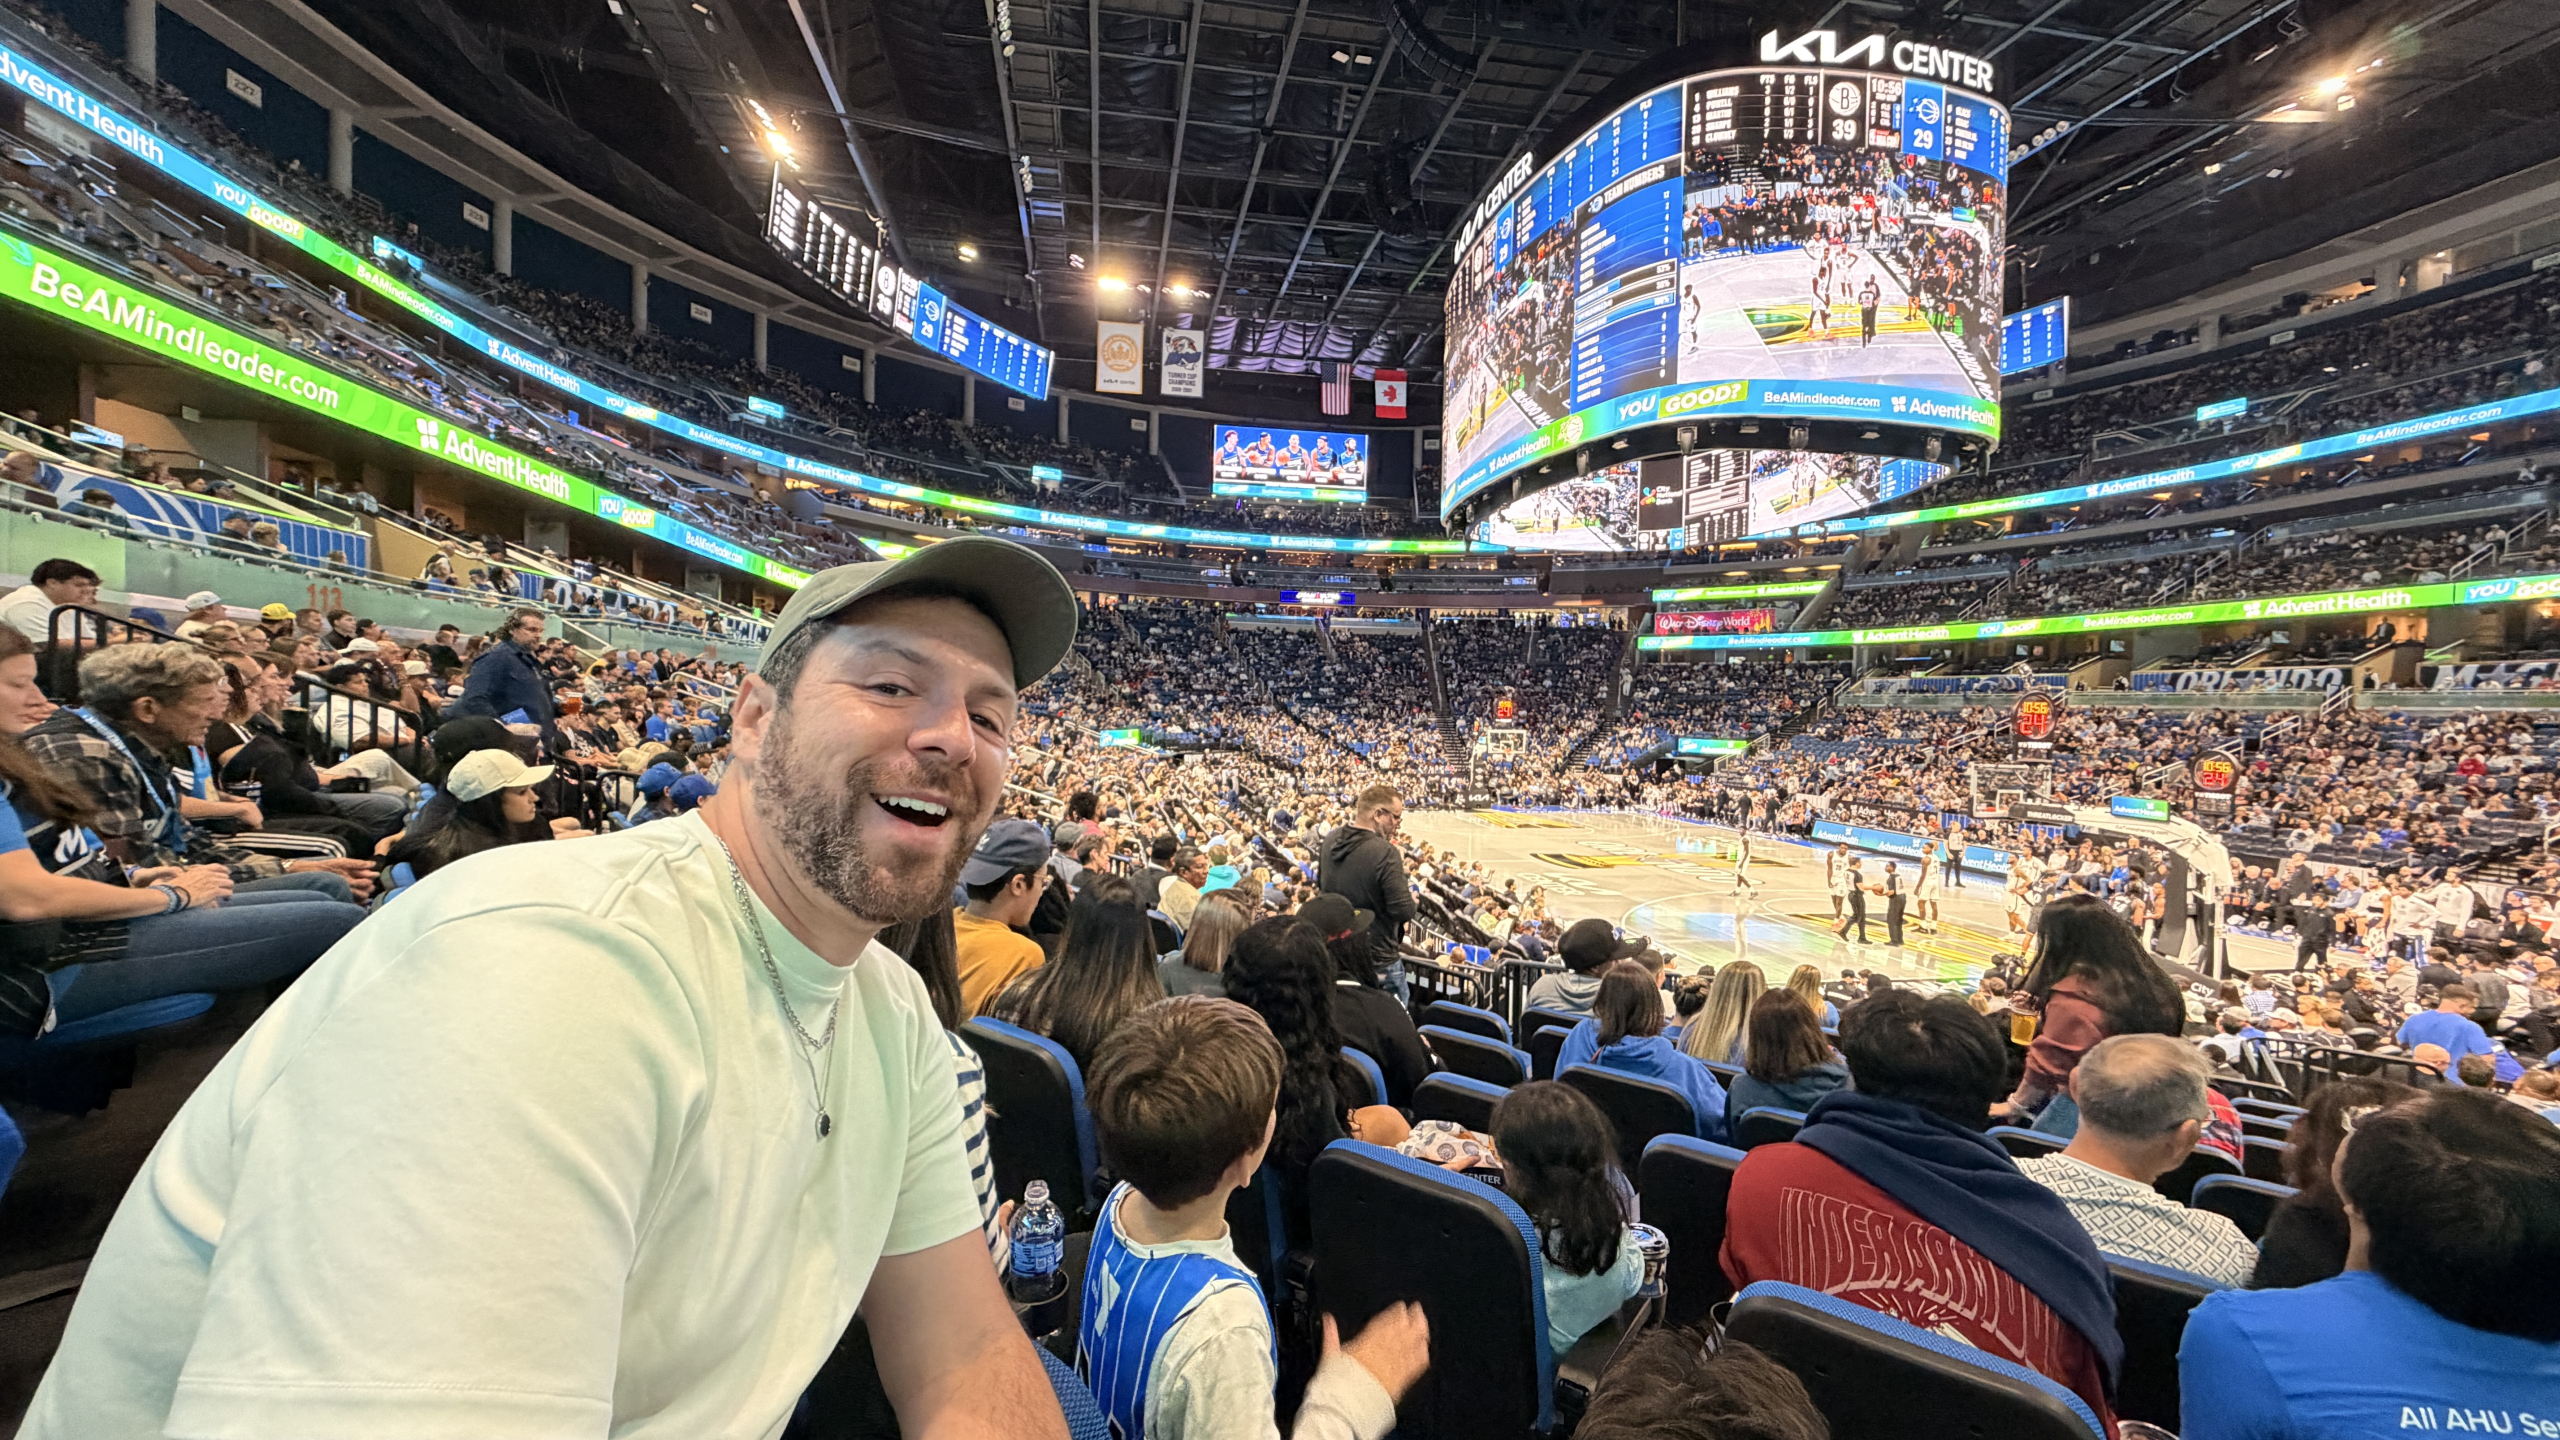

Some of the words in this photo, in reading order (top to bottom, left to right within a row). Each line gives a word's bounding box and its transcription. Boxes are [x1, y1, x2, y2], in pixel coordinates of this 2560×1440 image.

[1760, 29, 1886, 67] KIA
[1893, 41, 1994, 93] CENTER
[1871, 78, 1902, 95] 10:56
[1832, 118, 1857, 141] 39
[1913, 128, 1934, 150] 29
[1484, 151, 1534, 219] CENTER
[1604, 183, 1623, 205] TEAM
[1623, 164, 1665, 193] NUMBERS
[213, 181, 247, 205] YOU
[250, 204, 301, 236] GOOD?
[355, 264, 455, 331] BeAMindleader.com
[30, 261, 339, 410] BeAMindleader.com
[501, 346, 581, 394] AdventHealth
[1618, 395, 1657, 421] YOU
[1664, 383, 1742, 414] GOOD?
[1764, 391, 1881, 409] BeAMindleader.com
[1909, 397, 1996, 428] AdventHealth
[2356, 405, 2503, 446] BeAMindleader.com
[1496, 434, 1551, 468] AdventHealth
[444, 429, 570, 501] AdventHealth
[796, 459, 862, 486] AdventHealth
[2100, 467, 2196, 495] AdventHealth
[599, 496, 621, 517] YOU
[622, 507, 654, 527] GOOD?
[2264, 589, 2412, 616] AdventHealth
[2468, 581, 2511, 600] YOU
[1723, 616, 1751, 627] World
[1979, 623, 2001, 635] YOU
[2083, 611, 2194, 628] BeAMindleader.com
[1866, 627, 1950, 643] AdventHealth
[2023, 700, 2049, 714] 10:56
[2019, 713, 2049, 737] 24
[2202, 760, 2232, 773] 10:56
[2202, 772, 2229, 788] 24
[1817, 829, 1860, 845] AdventHealth
[2400, 1406, 2438, 1431] All
[2446, 1407, 2513, 1435] AHU
[2518, 1412, 2560, 1440] Se
